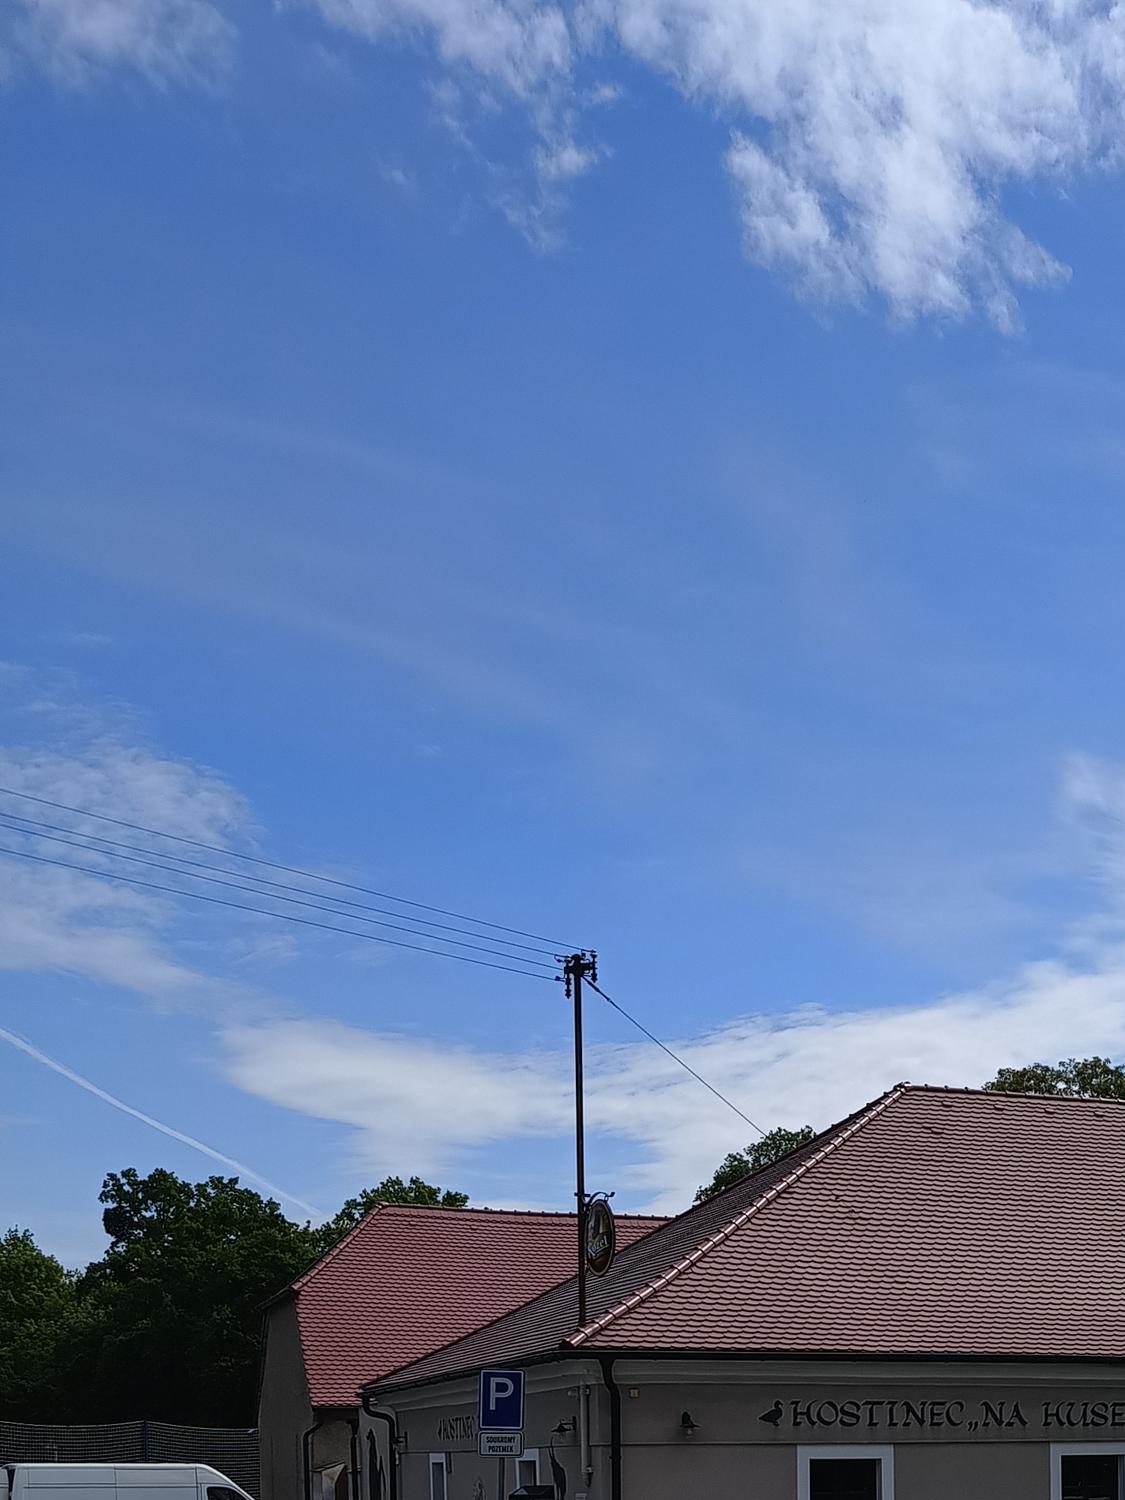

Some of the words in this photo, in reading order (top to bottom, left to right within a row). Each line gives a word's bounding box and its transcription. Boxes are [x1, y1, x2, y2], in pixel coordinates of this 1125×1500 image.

[587, 1234, 609, 1256] Kozel
[490, 1377, 514, 1411] P
[790, 1400, 965, 1427] HOSTINEC
